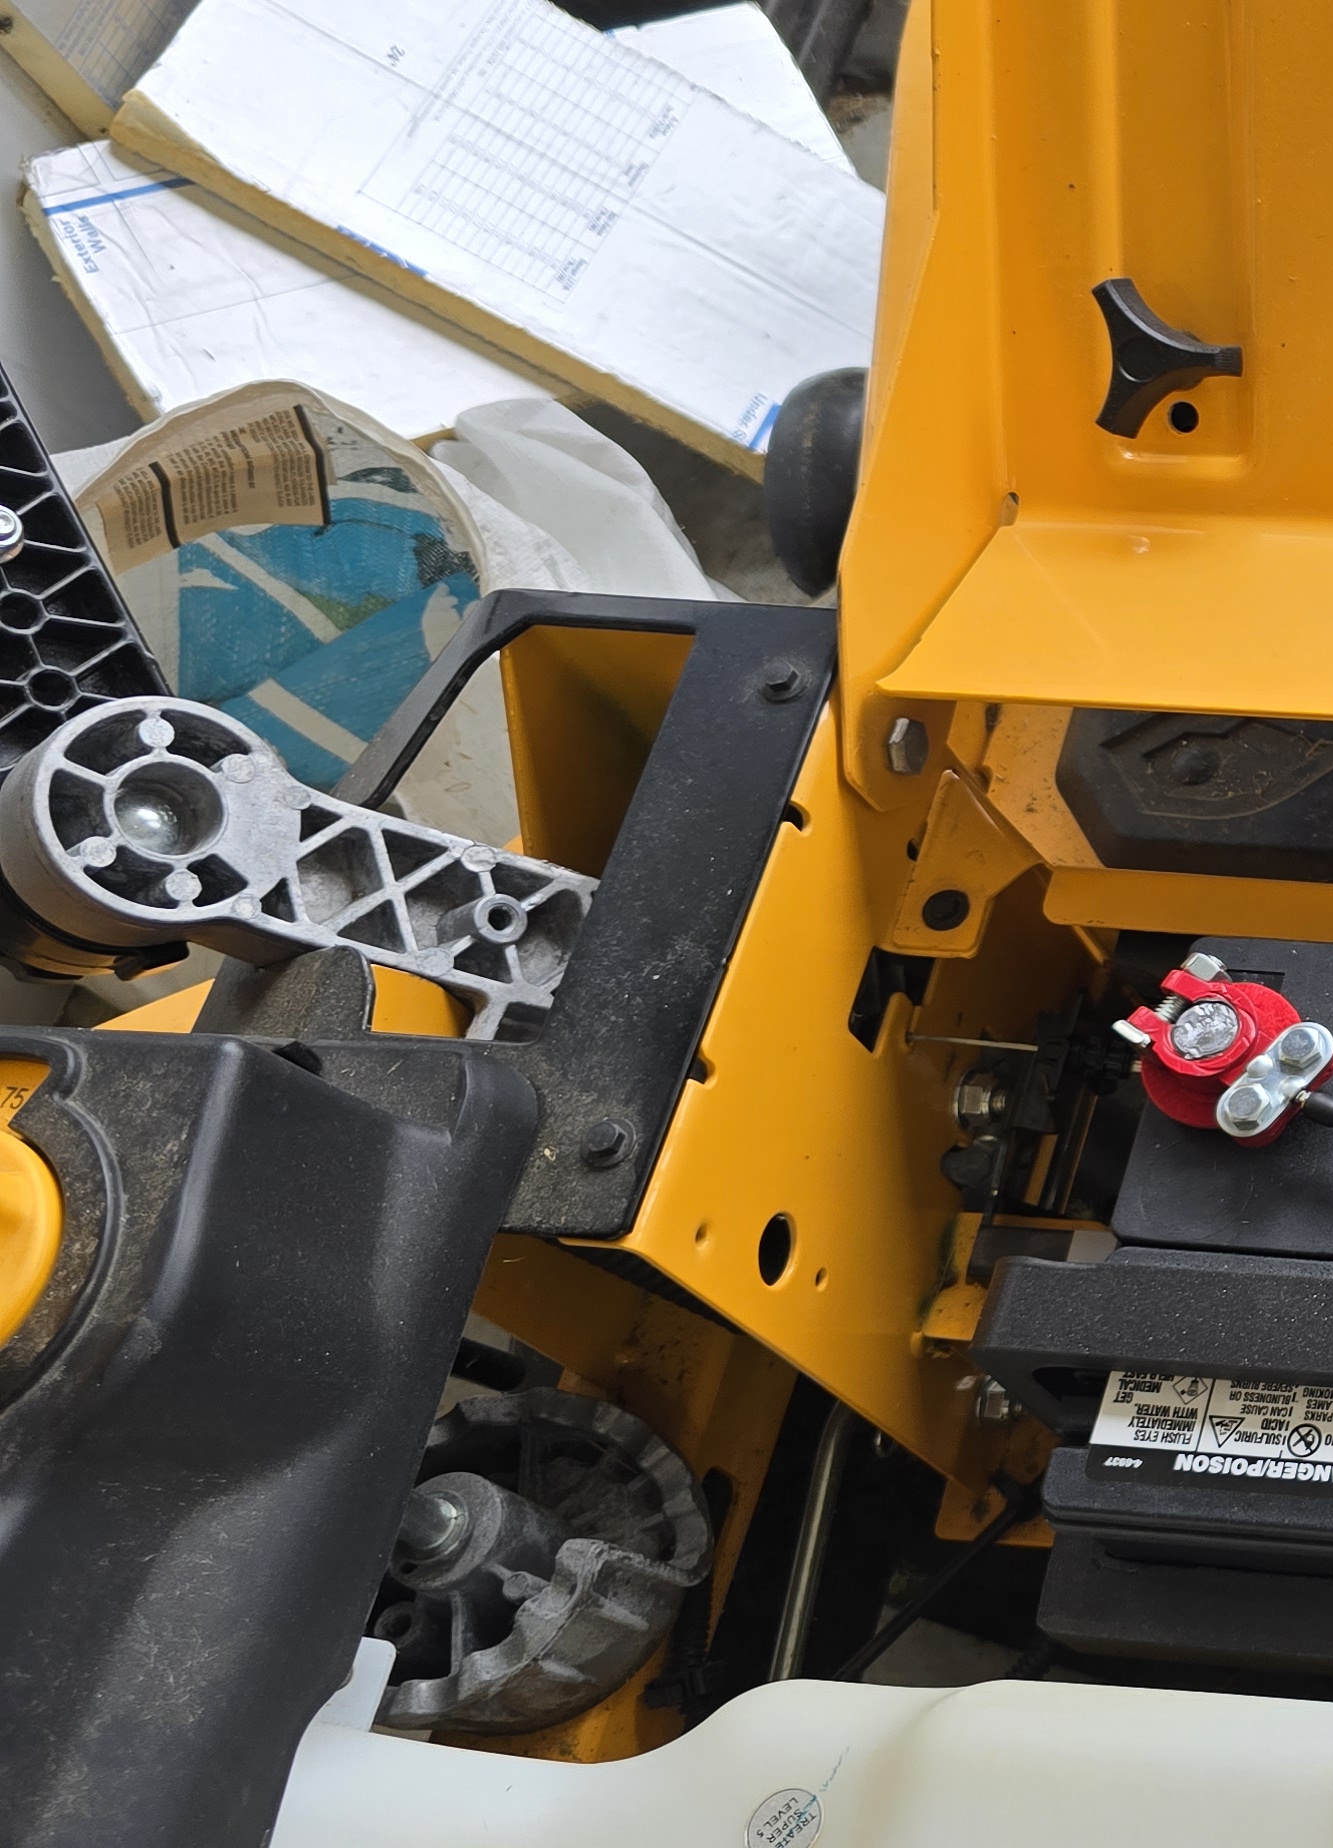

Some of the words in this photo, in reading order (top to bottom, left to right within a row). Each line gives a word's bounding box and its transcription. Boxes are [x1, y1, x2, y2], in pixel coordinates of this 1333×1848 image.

[78, 215, 106, 253] Walls
[58, 218, 99, 274] Exterior
[1117, 1378, 1162, 1393] MEDICAL
[1113, 1391, 1133, 1403] GET
[1229, 1391, 1242, 1401] OR
[1243, 1391, 1290, 1405] BLINDNESS
[1133, 1403, 1170, 1417] WATER.
[1171, 1405, 1198, 1419] WITH
[1240, 1404, 1268, 1416] CAUSE
[1269, 1405, 1288, 1416] CAN
[1127, 1415, 1195, 1431] IMMEDIATELY
[1260, 1418, 1285, 1430] ACID
[1133, 1429, 1159, 1442] EYES
[1161, 1431, 1192, 1444] FLUSH
[1233, 1430, 1282, 1445] SULFURIC
[763, 1797, 798, 1827] LEVEL
[756, 1829, 764, 1837] 5
[766, 1809, 802, 1843] SUPER
